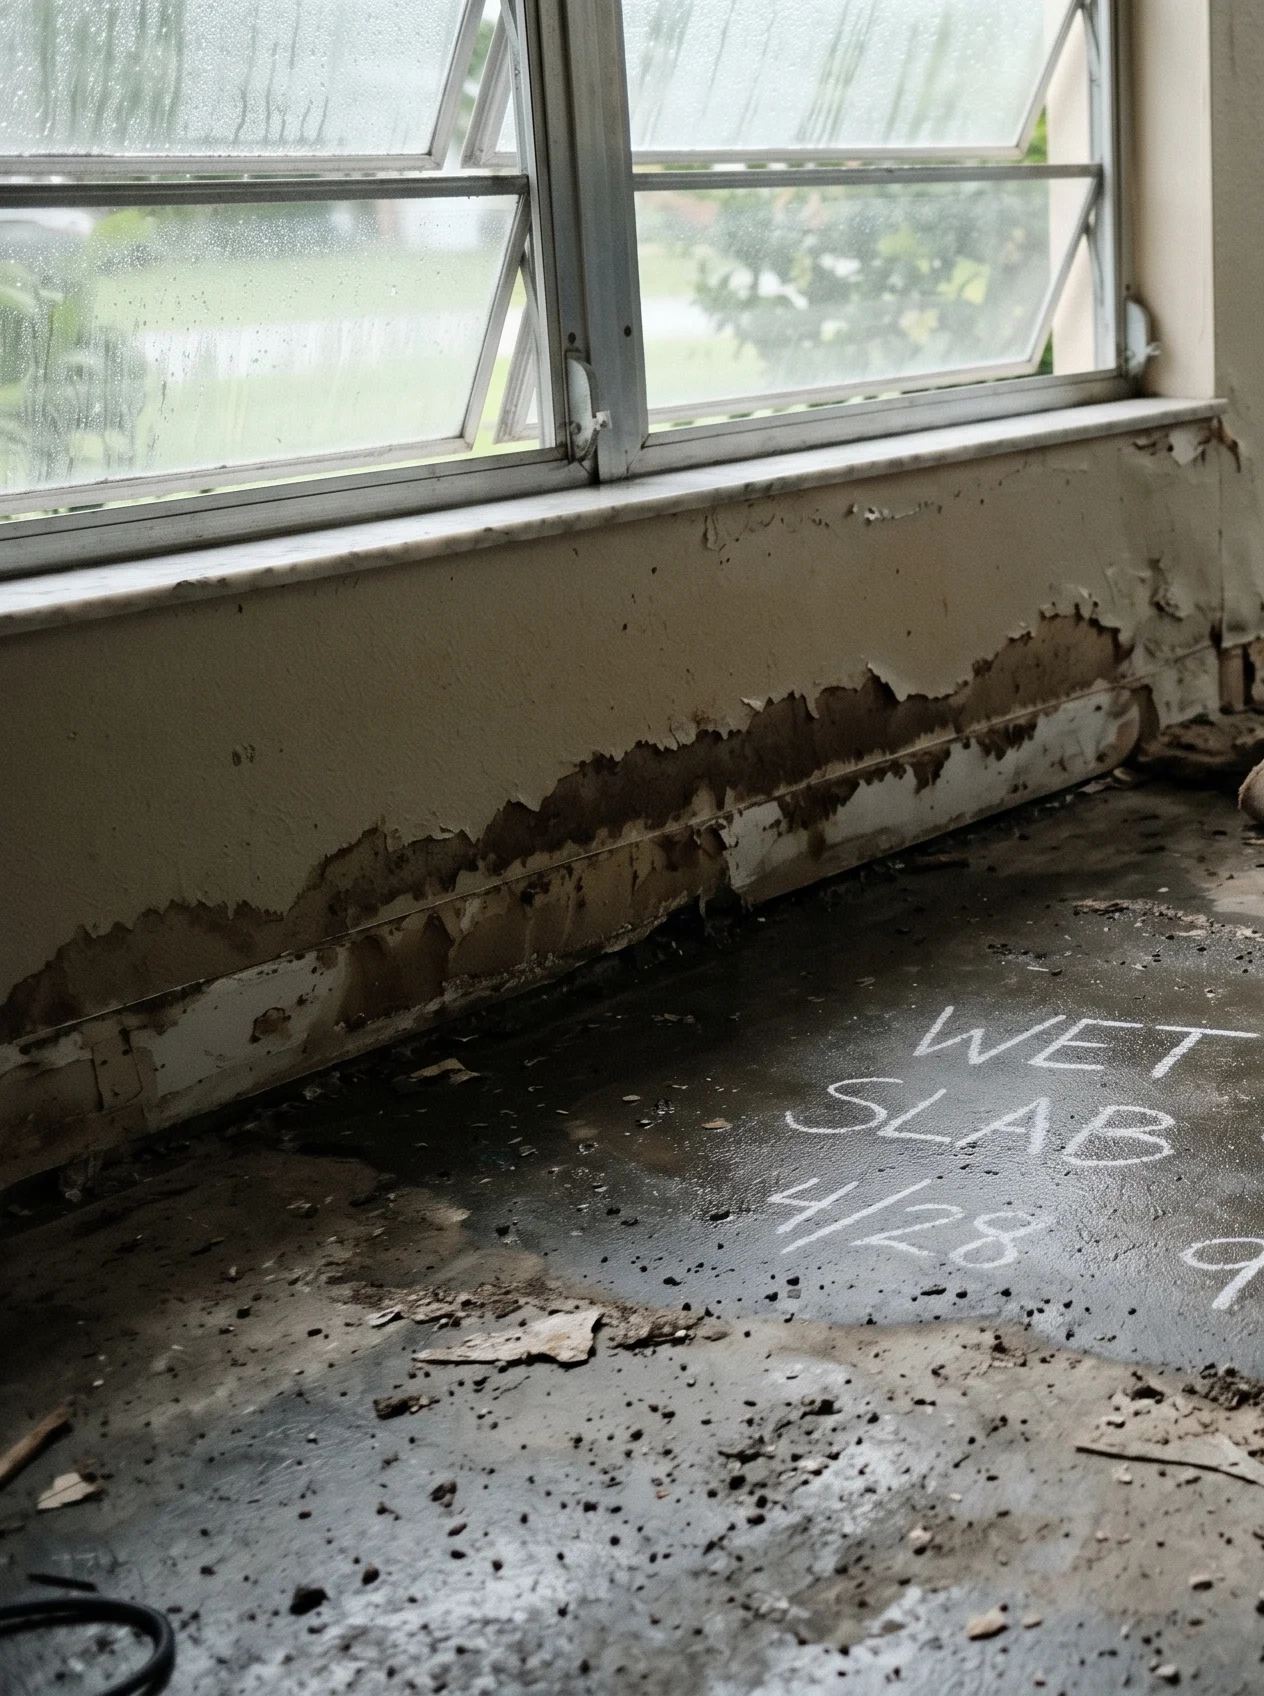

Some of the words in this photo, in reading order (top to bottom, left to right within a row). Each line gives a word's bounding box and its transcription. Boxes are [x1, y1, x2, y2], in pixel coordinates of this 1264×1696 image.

[914, 1005, 1260, 1078] WET
[784, 1077, 1177, 1167] SLAB
[767, 1177, 1053, 1269] 4/28
